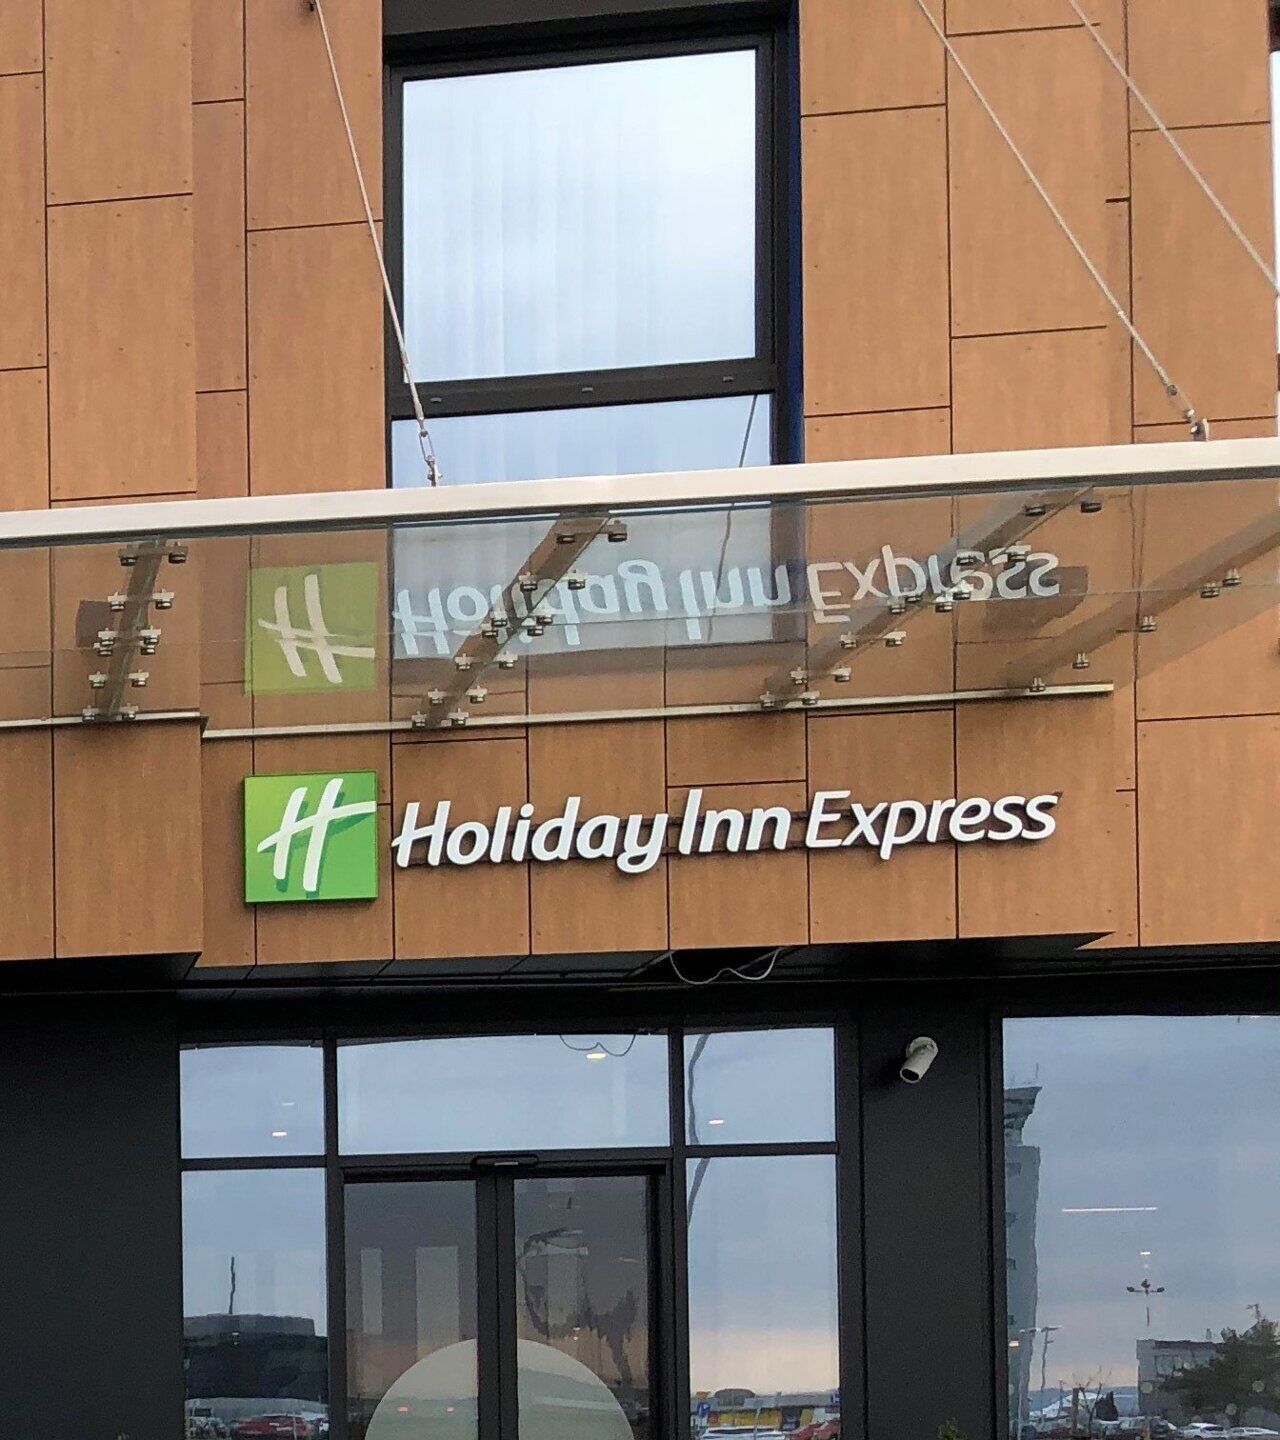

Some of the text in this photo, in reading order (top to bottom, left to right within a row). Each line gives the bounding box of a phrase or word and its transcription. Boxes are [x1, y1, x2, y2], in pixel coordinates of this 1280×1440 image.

[391, 796, 668, 874] Holiday
[677, 788, 792, 856] Inn
[805, 789, 1059, 861] Express
